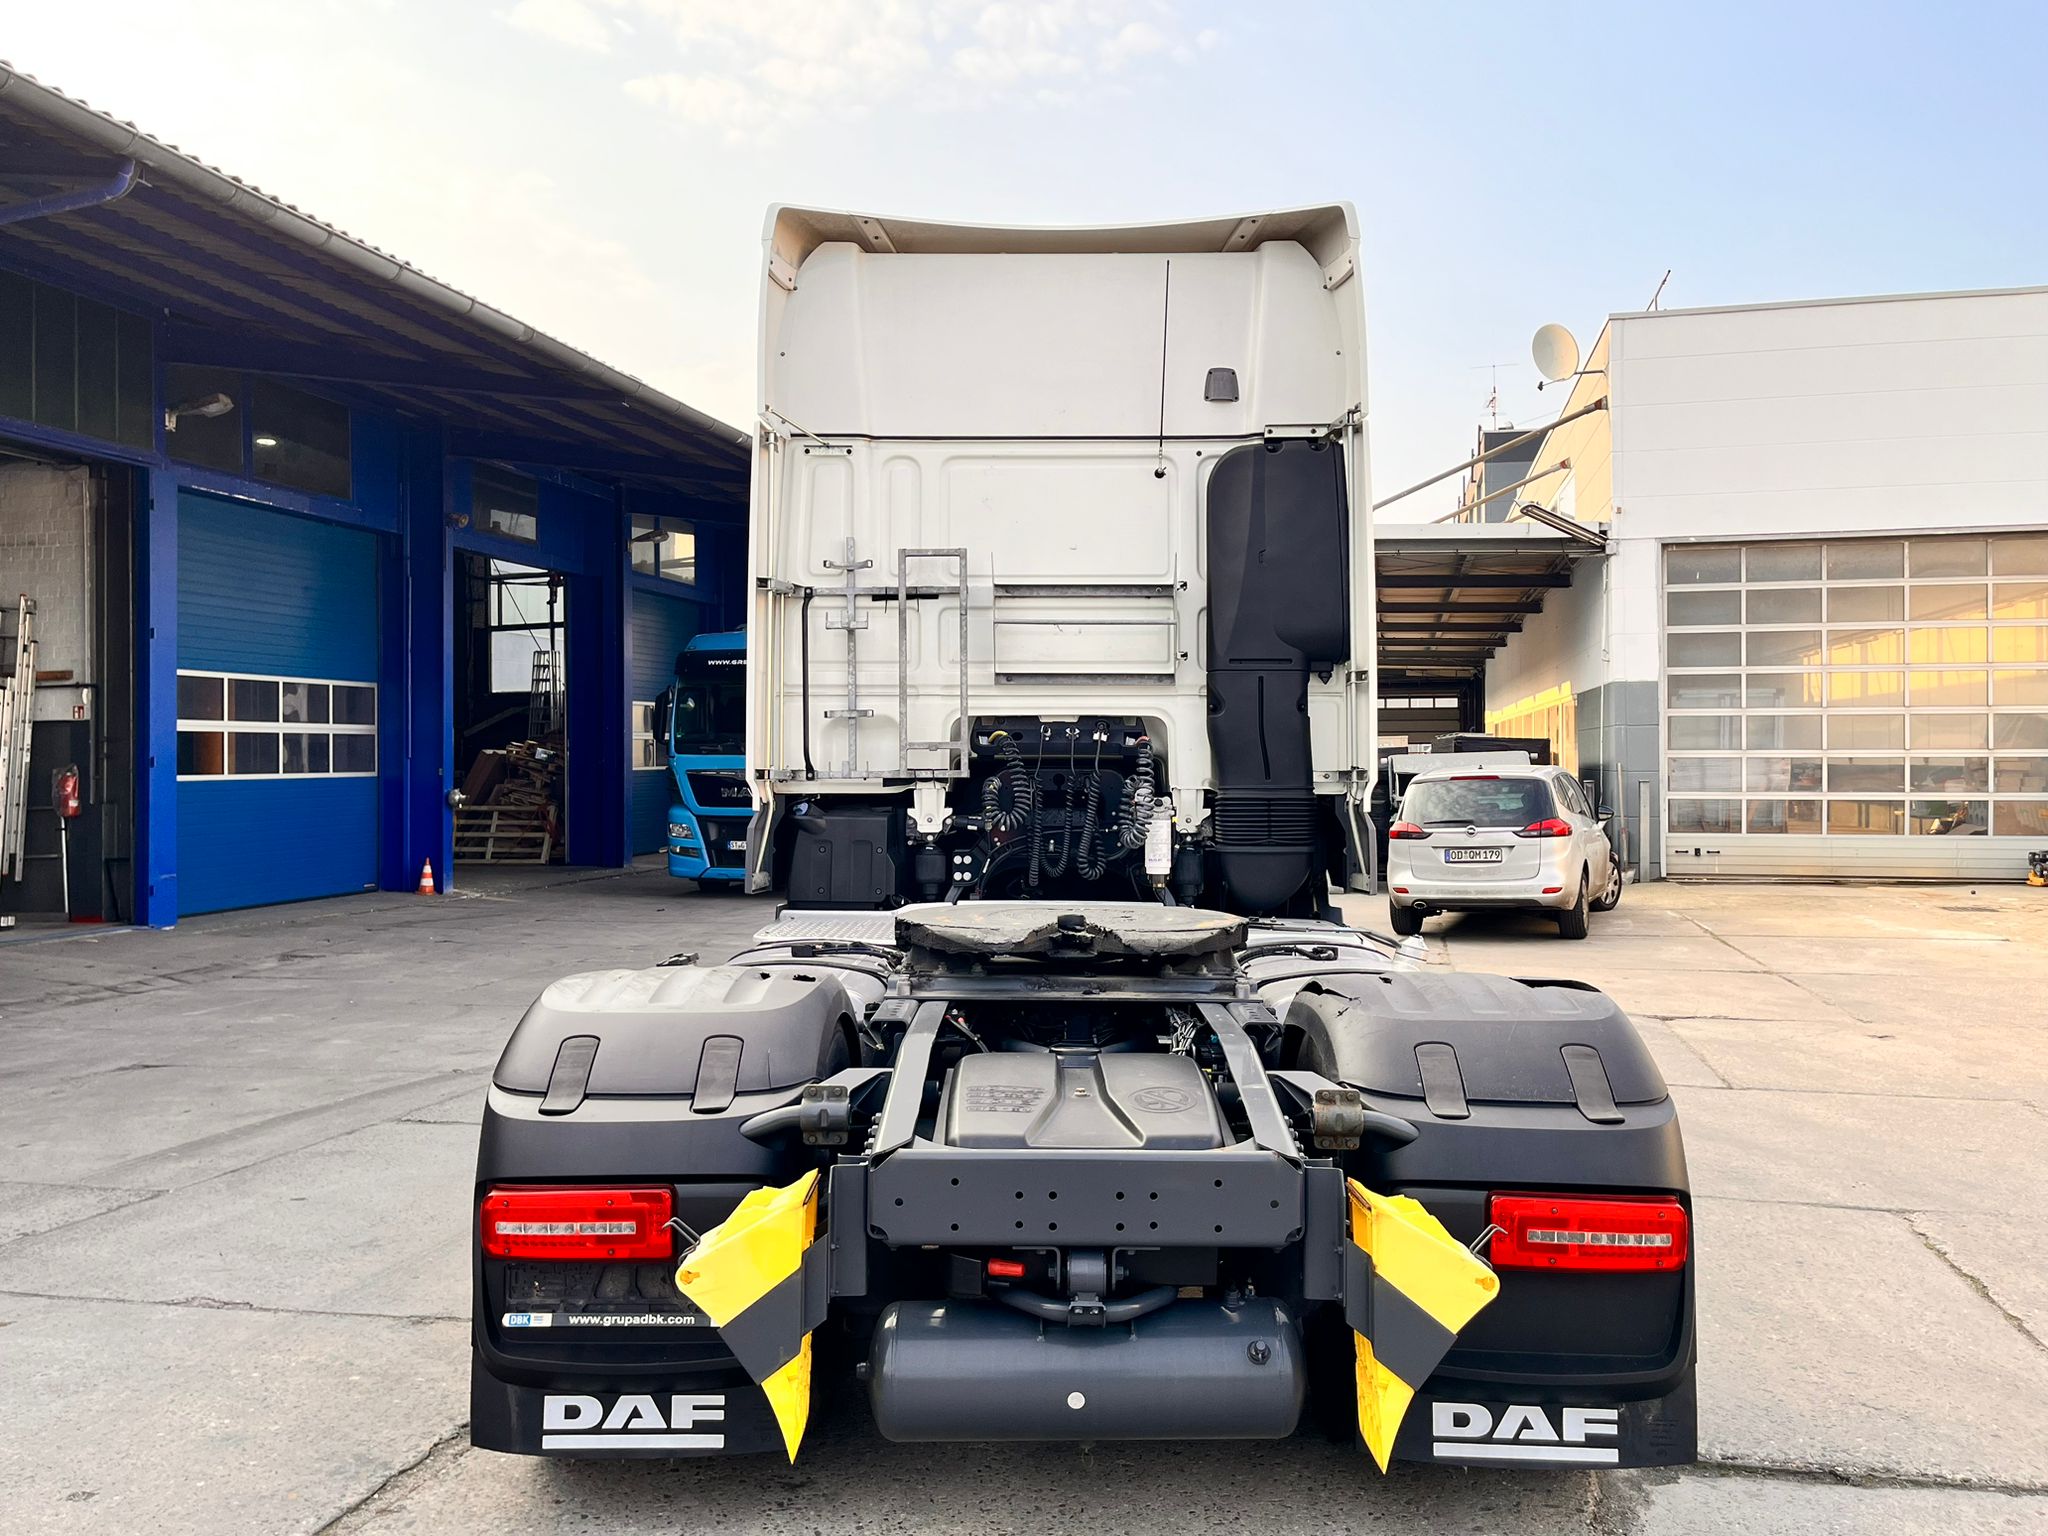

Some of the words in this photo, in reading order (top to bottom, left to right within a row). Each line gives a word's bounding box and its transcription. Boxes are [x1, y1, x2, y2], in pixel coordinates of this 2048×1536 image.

[1451, 850, 1463, 860] OD
[1483, 850, 1501, 860] 179
[510, 1314, 531, 1325] DBK
[568, 1314, 695, 1327] www.grupadbk.com
[543, 1395, 725, 1430] DAF
[1432, 1402, 1618, 1441] DAF
